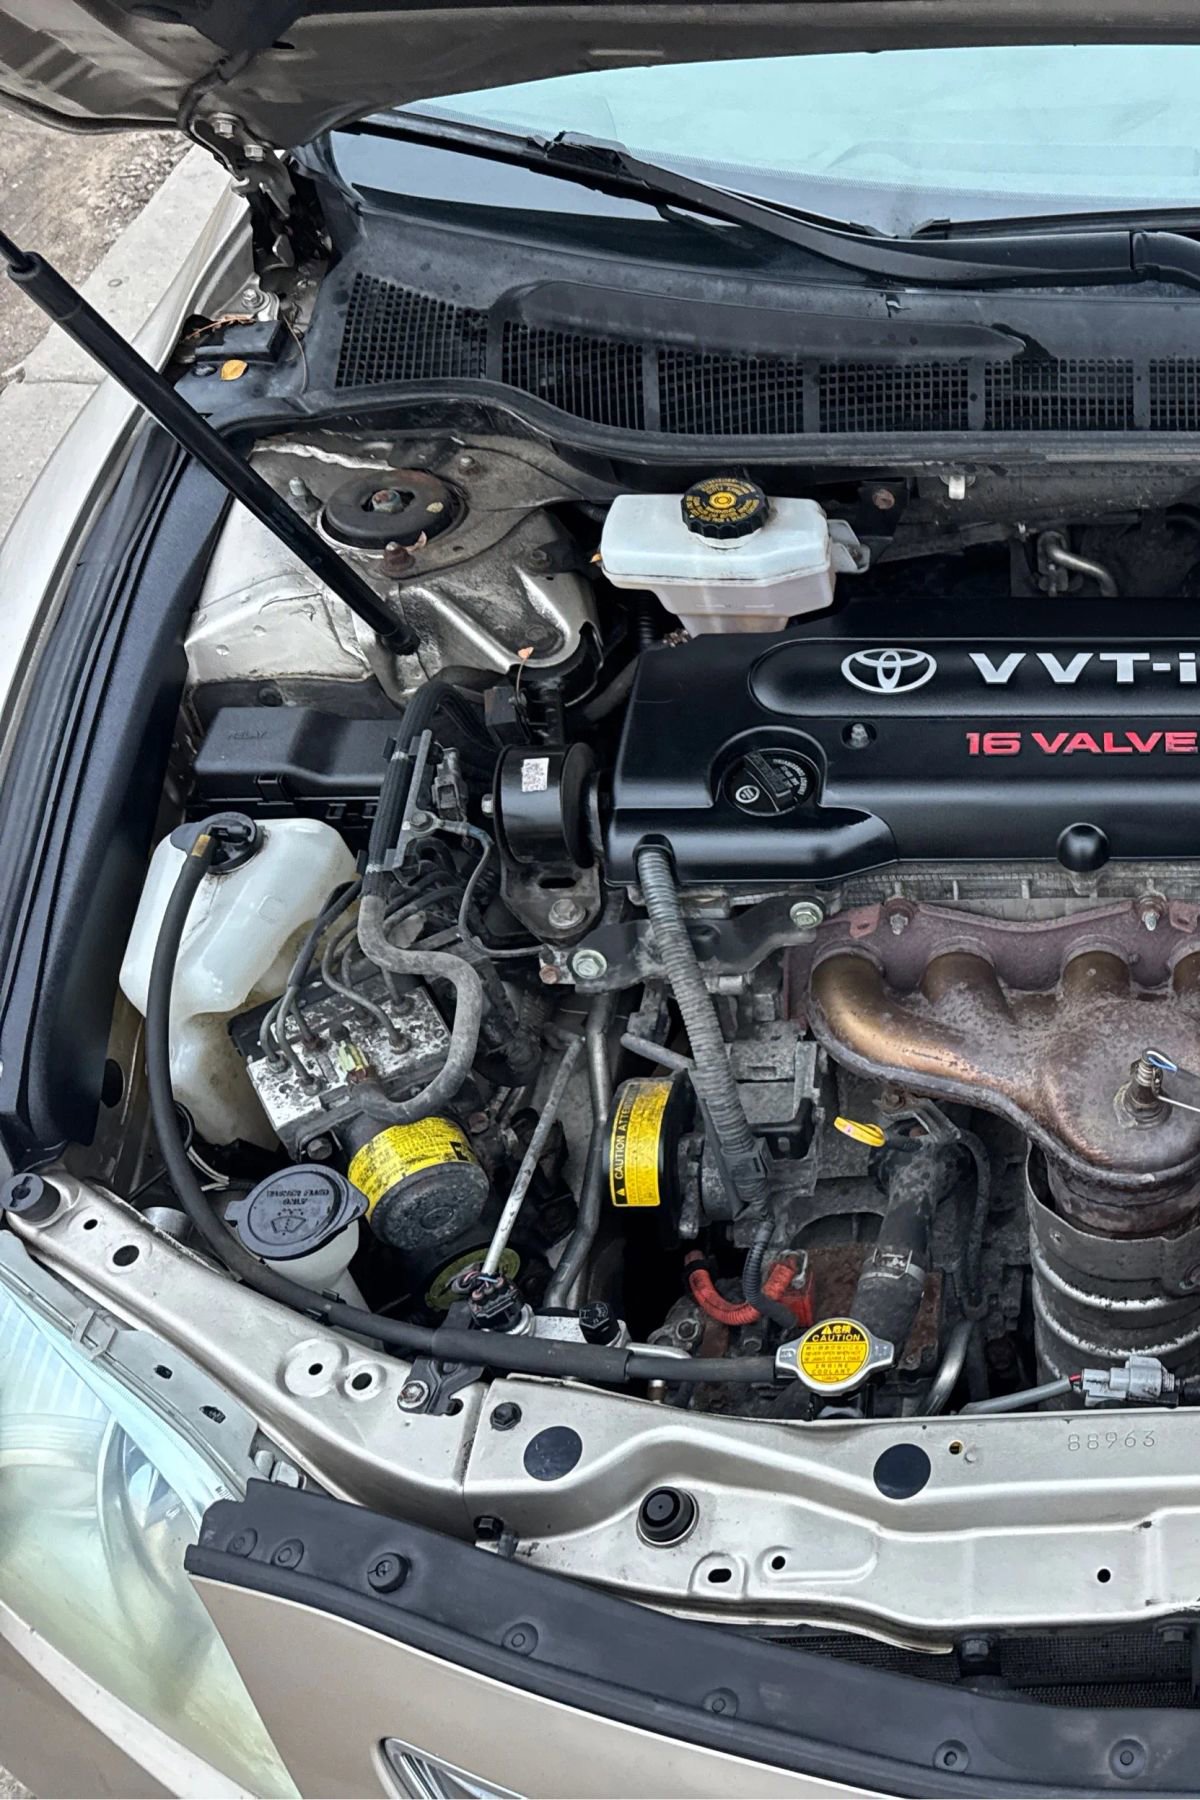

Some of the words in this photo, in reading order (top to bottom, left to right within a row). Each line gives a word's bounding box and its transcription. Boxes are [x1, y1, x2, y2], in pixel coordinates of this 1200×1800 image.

[968, 652, 1198, 684] VVT-i
[966, 732, 1021, 755] 16
[1031, 731, 1199, 755] VALVE
[614, 1135, 625, 1180] CAUTION
[812, 1334, 860, 1342] CAUTION
[1067, 1429, 1156, 1452] 88963
